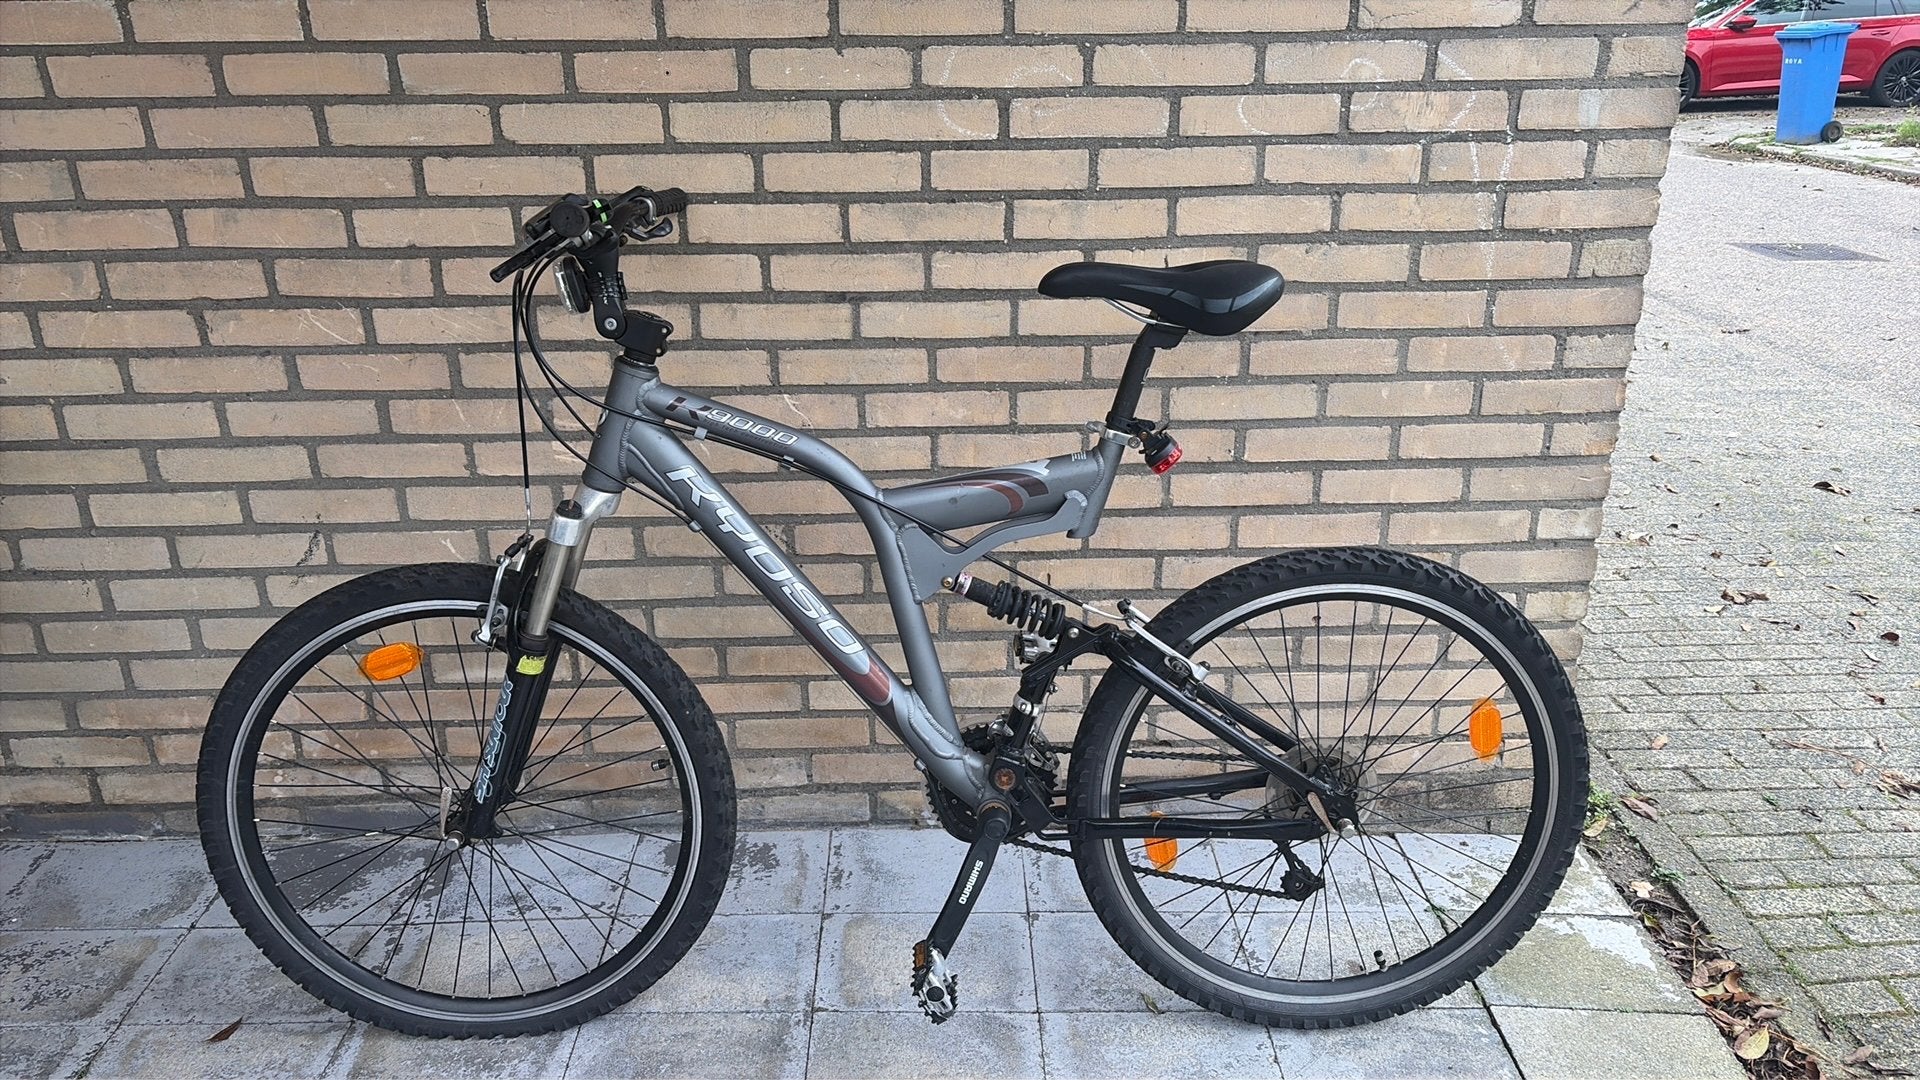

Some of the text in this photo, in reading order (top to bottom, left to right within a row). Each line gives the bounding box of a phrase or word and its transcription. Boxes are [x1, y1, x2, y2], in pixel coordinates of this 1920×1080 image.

[665, 396, 799, 446] K9000
[666, 464, 865, 655] KYOSO
[958, 859, 984, 905] SHIMANO
